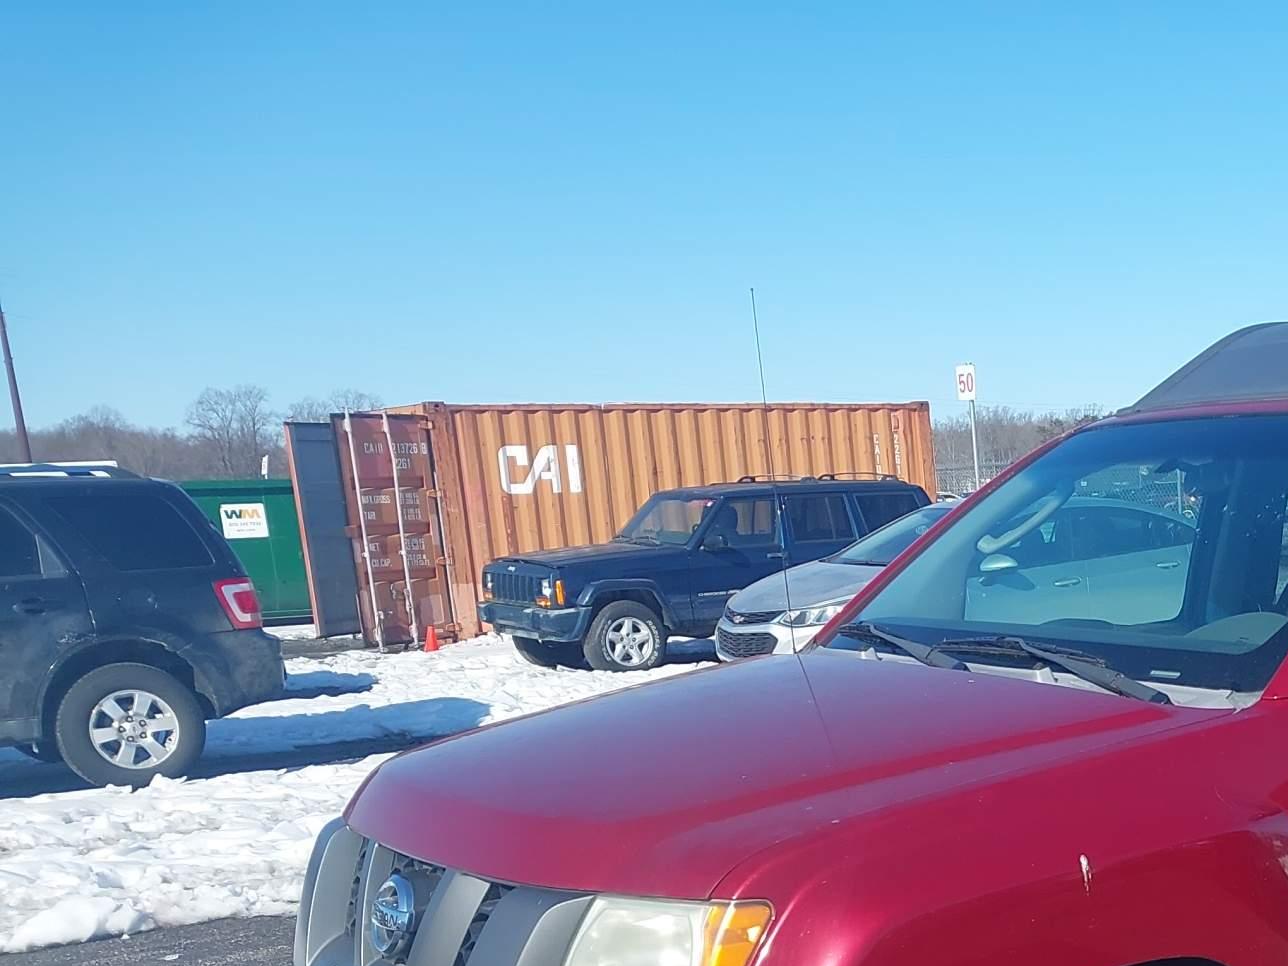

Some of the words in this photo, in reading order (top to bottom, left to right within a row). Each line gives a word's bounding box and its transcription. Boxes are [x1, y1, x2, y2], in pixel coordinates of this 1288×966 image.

[958, 372, 974, 393] 50
[498, 444, 582, 495] CAI
[223, 508, 261, 520] WM
